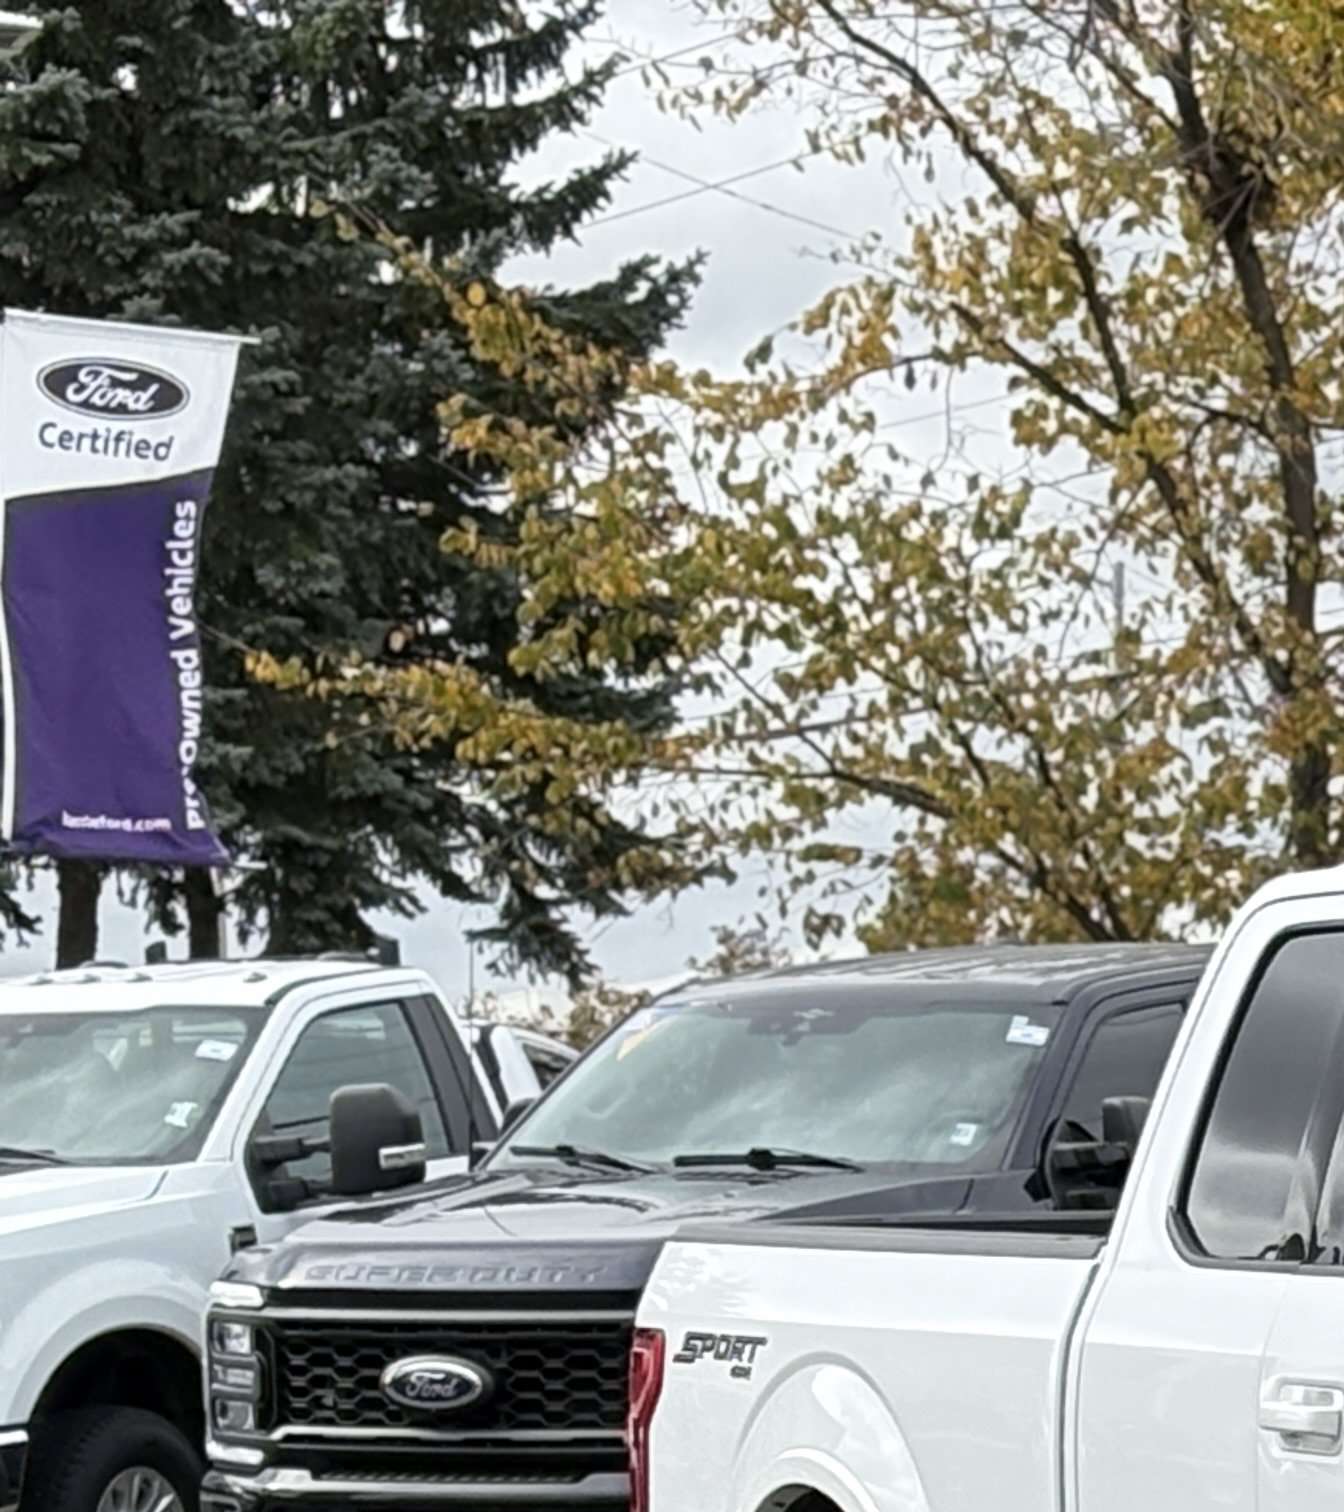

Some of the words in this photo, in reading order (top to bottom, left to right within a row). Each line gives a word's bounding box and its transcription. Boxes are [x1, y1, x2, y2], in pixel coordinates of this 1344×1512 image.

[65, 364, 160, 412] Ford
[38, 421, 175, 461] Certified
[164, 500, 198, 640] Vehicles
[303, 1263, 464, 1284] SUPER
[468, 1264, 609, 1285] DUTY
[671, 1330, 769, 1365] SPORT
[404, 1371, 461, 1398] Ford
